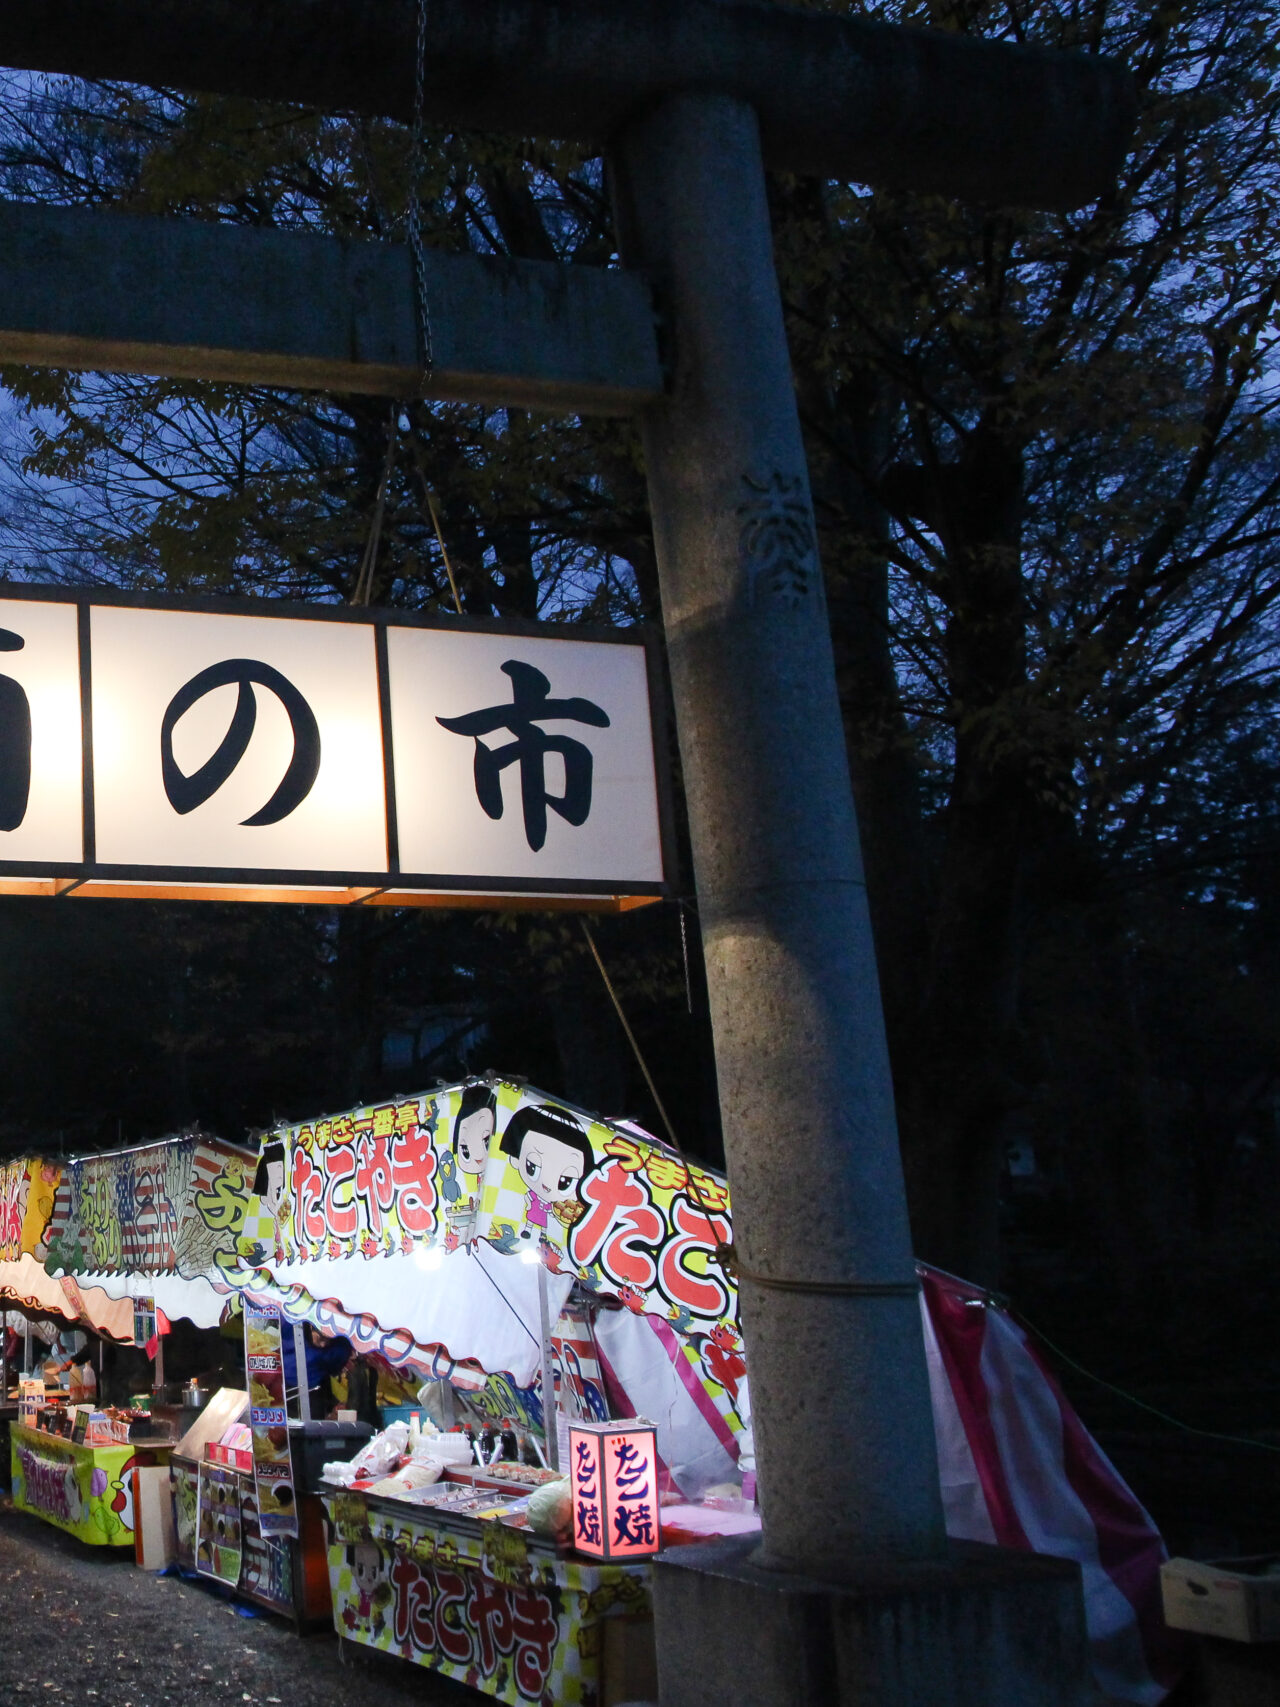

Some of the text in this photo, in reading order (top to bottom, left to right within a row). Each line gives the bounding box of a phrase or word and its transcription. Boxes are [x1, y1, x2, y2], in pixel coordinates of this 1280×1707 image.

[297, 1101, 421, 1152] うまさ一番亭
[291, 1127, 439, 1248] たこやき
[576, 1440, 602, 1547] たこ焼
[613, 1442, 656, 1547] たこ焼
[389, 1551, 560, 1702] たこやき
